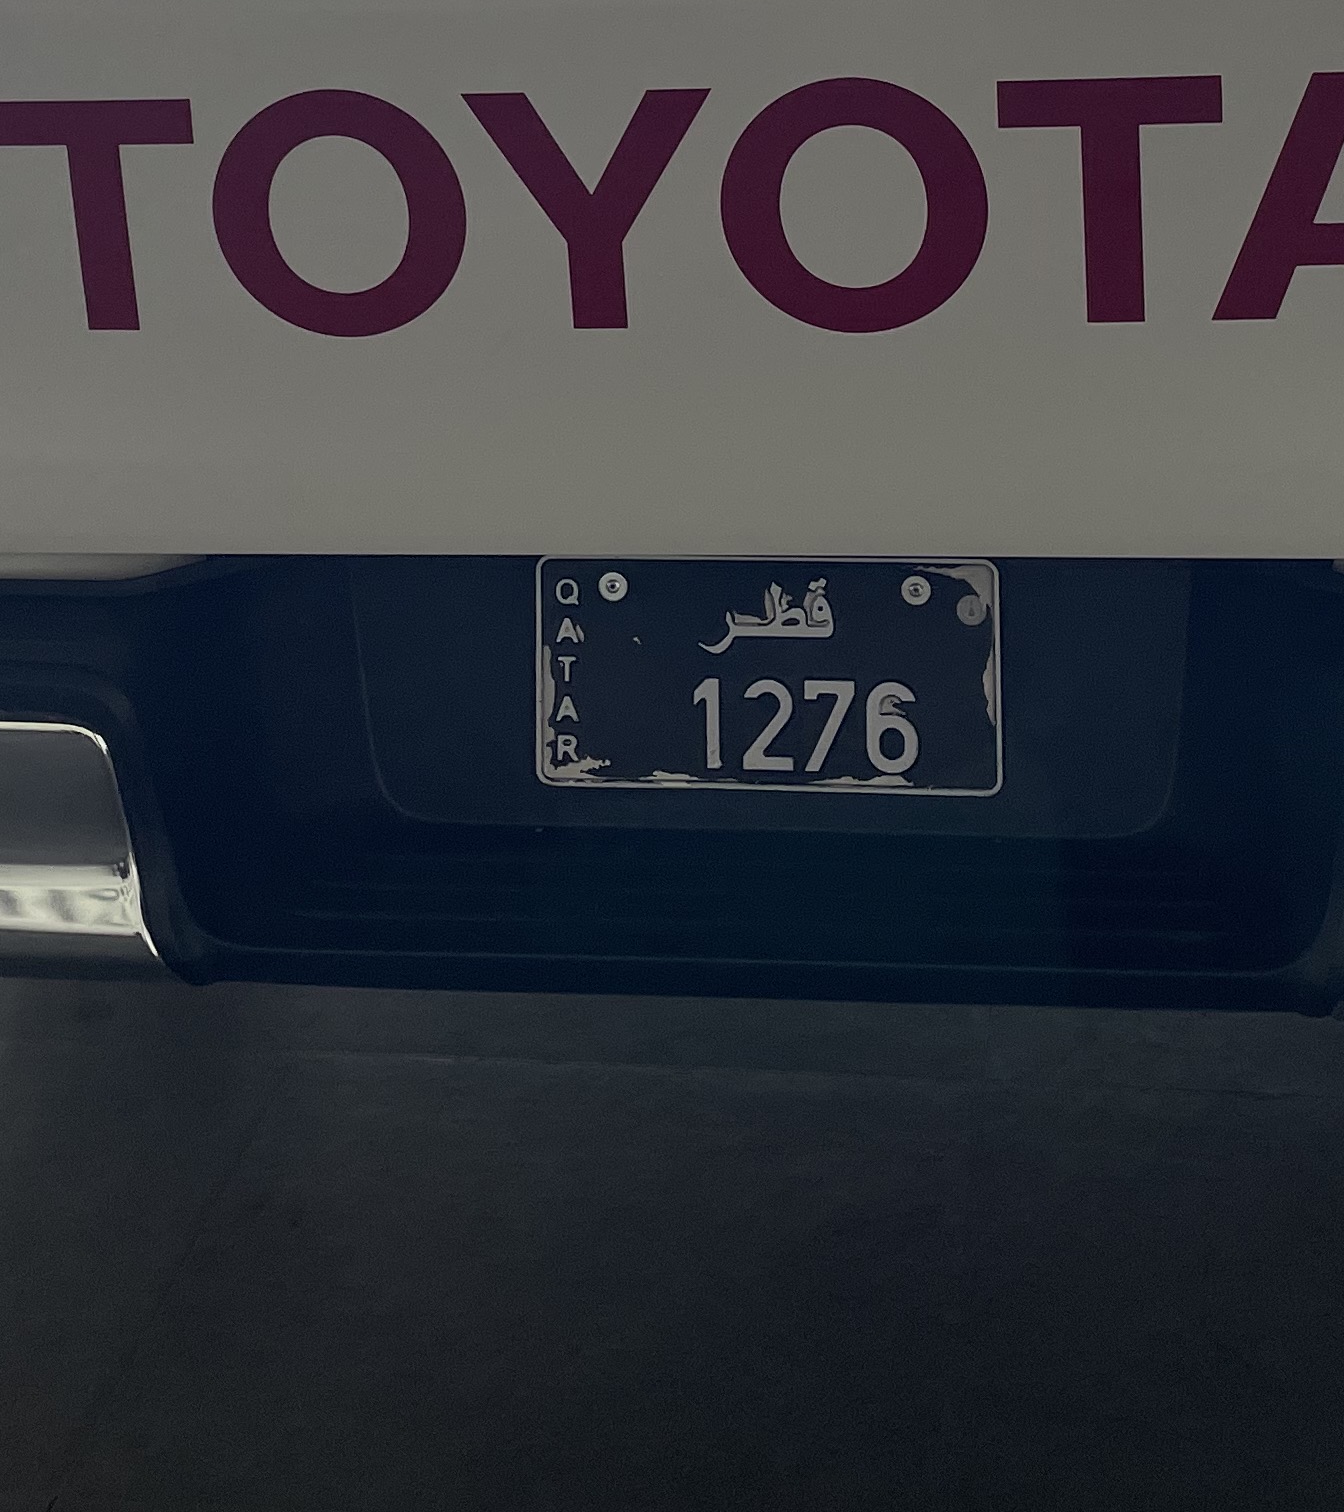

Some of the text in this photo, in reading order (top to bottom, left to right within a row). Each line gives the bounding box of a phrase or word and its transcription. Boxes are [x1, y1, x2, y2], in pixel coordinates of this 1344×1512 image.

[697, 577, 834, 654] قطر
[555, 578, 580, 762] QATAR
[692, 678, 920, 774] 1276
